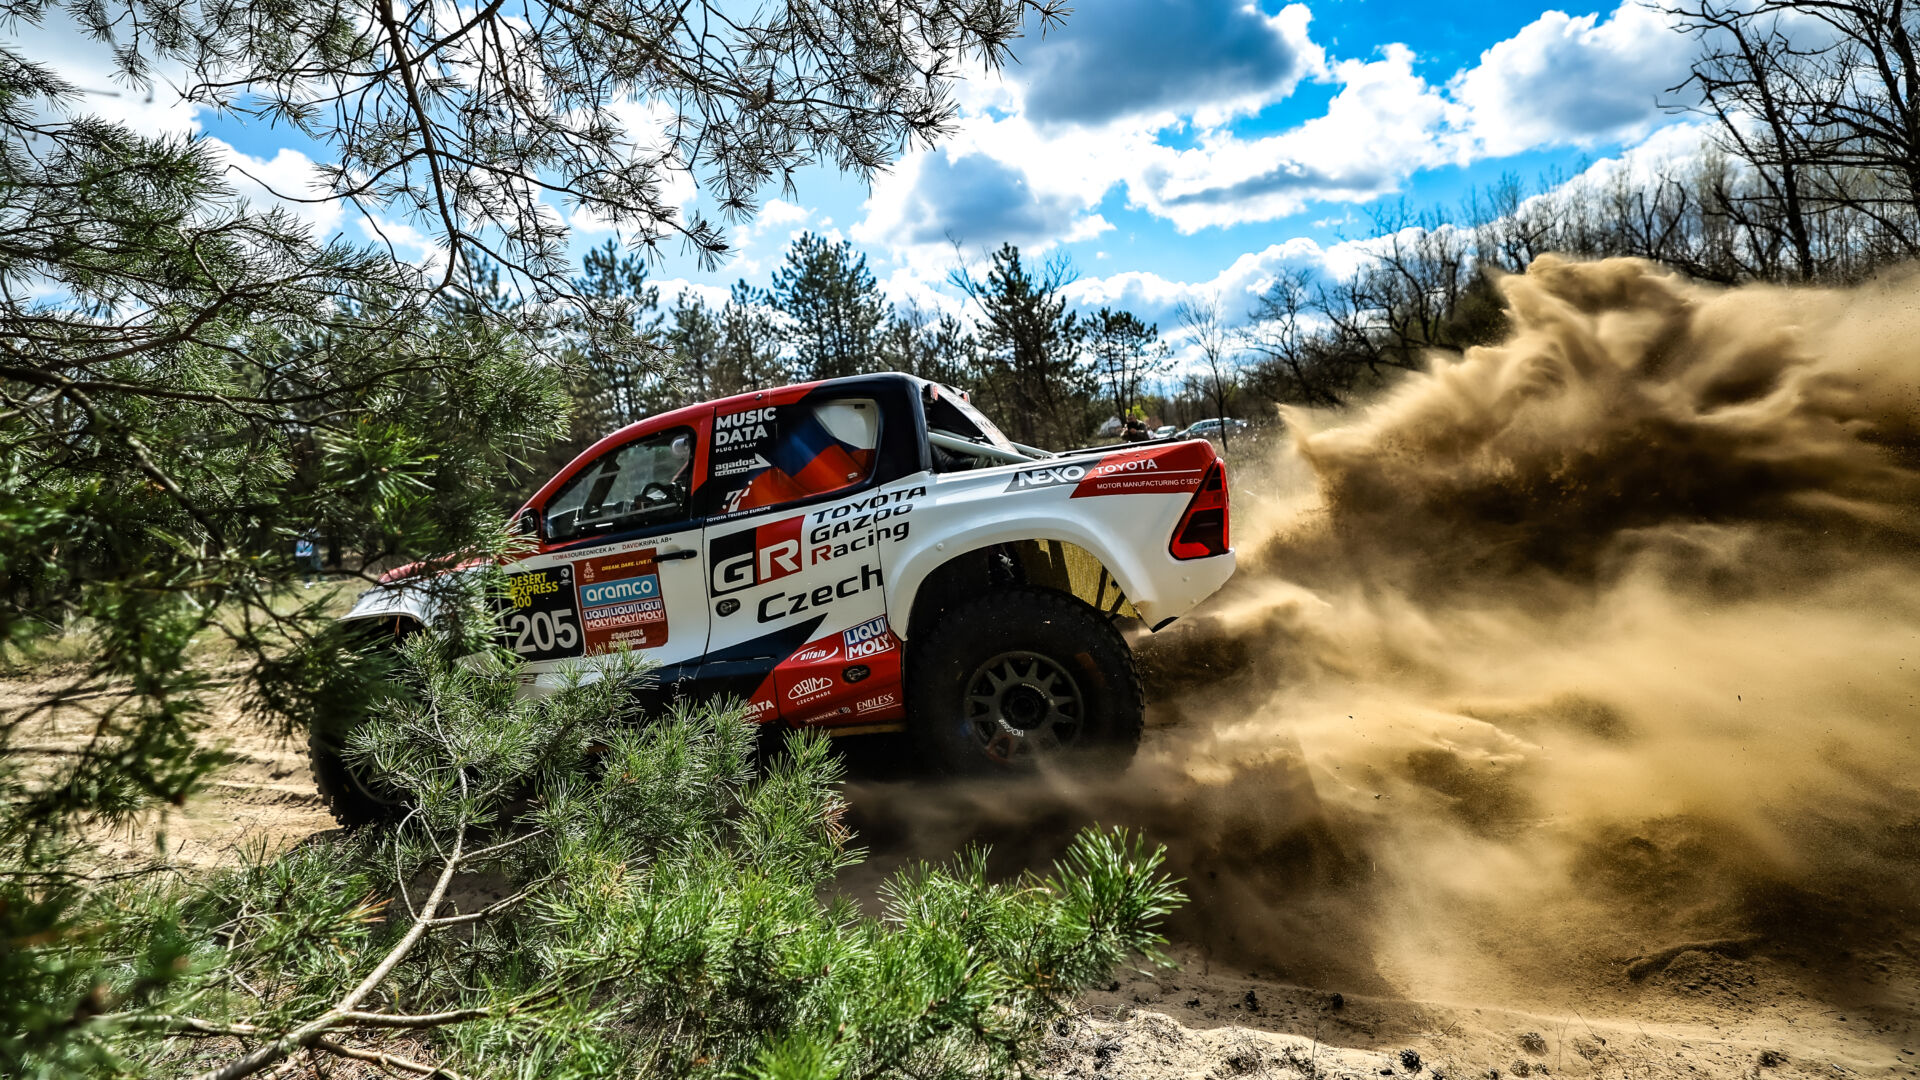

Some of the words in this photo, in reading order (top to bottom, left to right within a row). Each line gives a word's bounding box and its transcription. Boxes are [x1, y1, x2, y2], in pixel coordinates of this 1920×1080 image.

[716, 407, 776, 430] MUSIC
[715, 424, 768, 445] DATA
[741, 442, 757, 451] PLAY
[715, 458, 755, 471] agados
[1096, 459, 1158, 475] TOYOTA
[1018, 465, 1085, 487] NEXO
[1097, 482, 1122, 490] MOTOR
[1123, 479, 1179, 489] MANUFACTURING
[706, 514, 727, 522] TOYOTA
[728, 510, 749, 518] TSUSHO
[749, 506, 771, 514] EUROPE
[812, 485, 927, 524] TOYOTA
[810, 503, 914, 545] GAZOO
[811, 521, 910, 566] Racing
[713, 539, 800, 592] GR
[510, 572, 547, 587] DESERT
[510, 581, 558, 597] EXPRESS
[586, 581, 652, 601] aramco
[757, 564, 884, 624] Czech
[512, 596, 532, 608] 300
[585, 610, 609, 620] LIQUI
[610, 604, 634, 616] LIQUI
[636, 601, 661, 611] LIQUI
[587, 618, 611, 628] MOLY
[613, 614, 637, 624] MOLY
[639, 610, 662, 620] MOLY
[510, 609, 577, 653] 205
[846, 618, 885, 645] LIQUI
[848, 633, 890, 659] MOLY
[793, 677, 824, 695] PRIM
[796, 696, 814, 706] CZECH
[815, 690, 831, 699] MADE
[856, 693, 895, 711] ENDLESS
